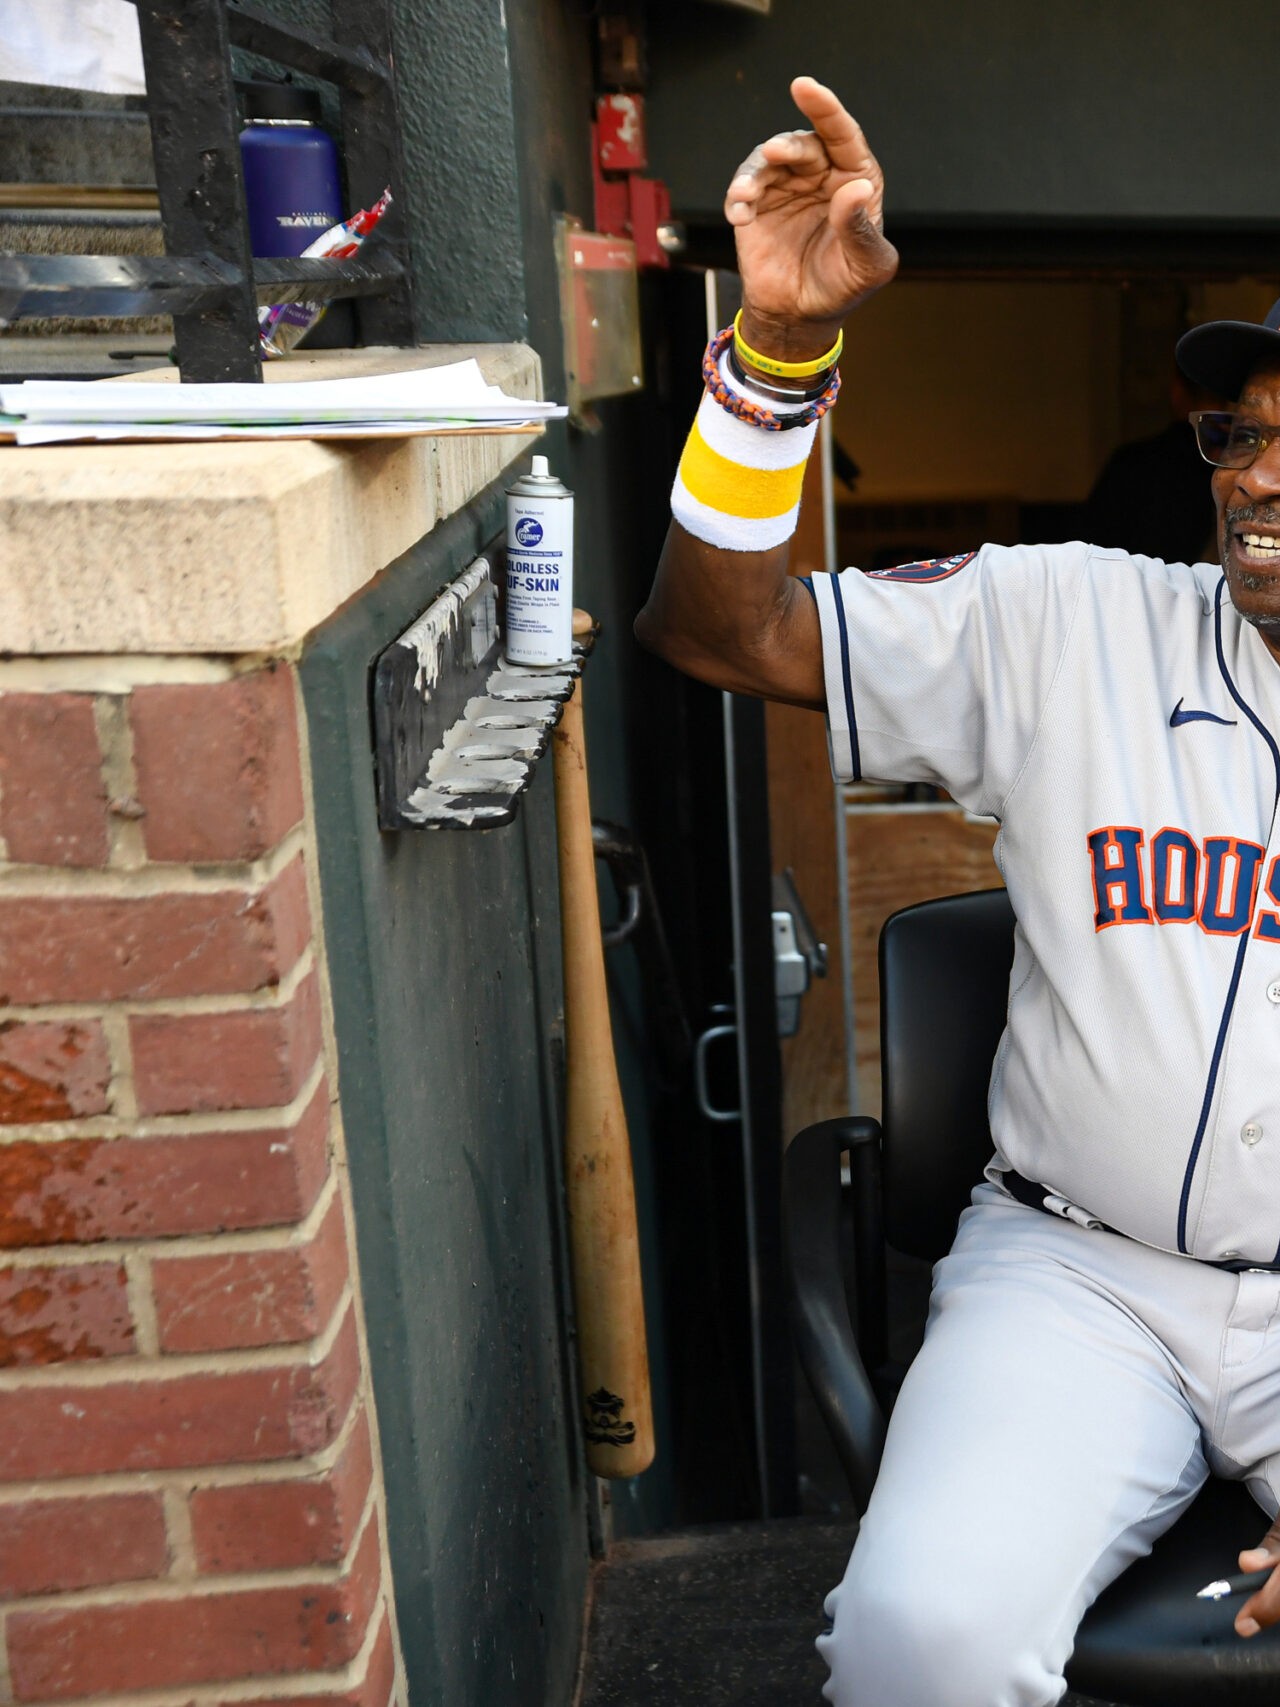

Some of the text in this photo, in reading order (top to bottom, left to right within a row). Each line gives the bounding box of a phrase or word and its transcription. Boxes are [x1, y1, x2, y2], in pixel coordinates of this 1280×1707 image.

[517, 528, 541, 544] Cramer
[506, 559, 559, 575] OLORLESS
[506, 574, 559, 592] UF-SKIN
